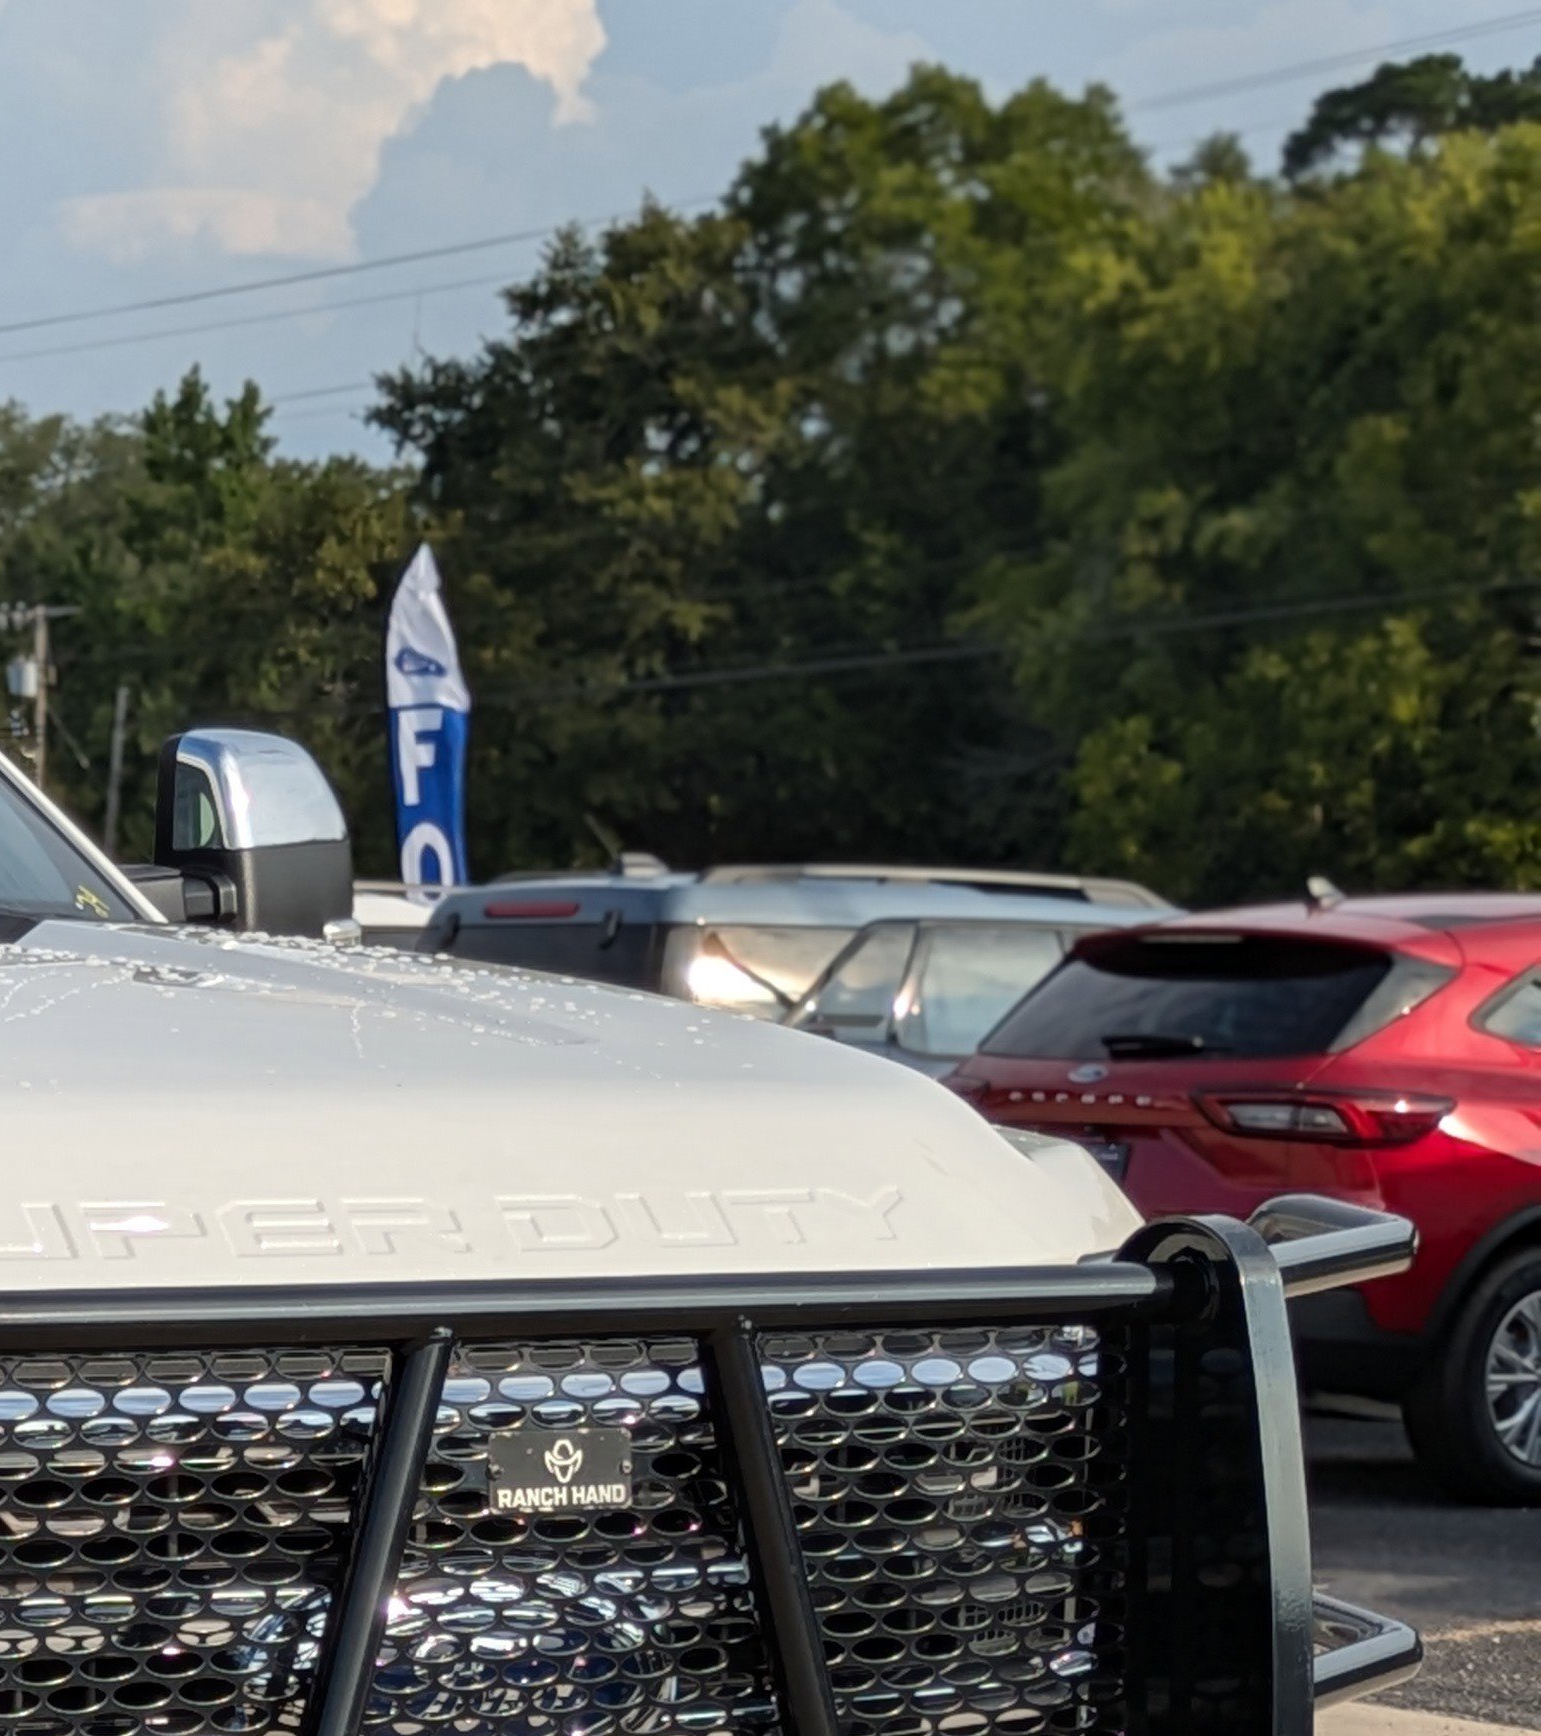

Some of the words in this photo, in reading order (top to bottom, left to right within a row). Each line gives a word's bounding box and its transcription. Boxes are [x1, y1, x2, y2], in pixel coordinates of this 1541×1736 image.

[495, 1184, 904, 1253] DUTY
[496, 1486, 567, 1509] RANCH
[571, 1483, 626, 1506] HAND
